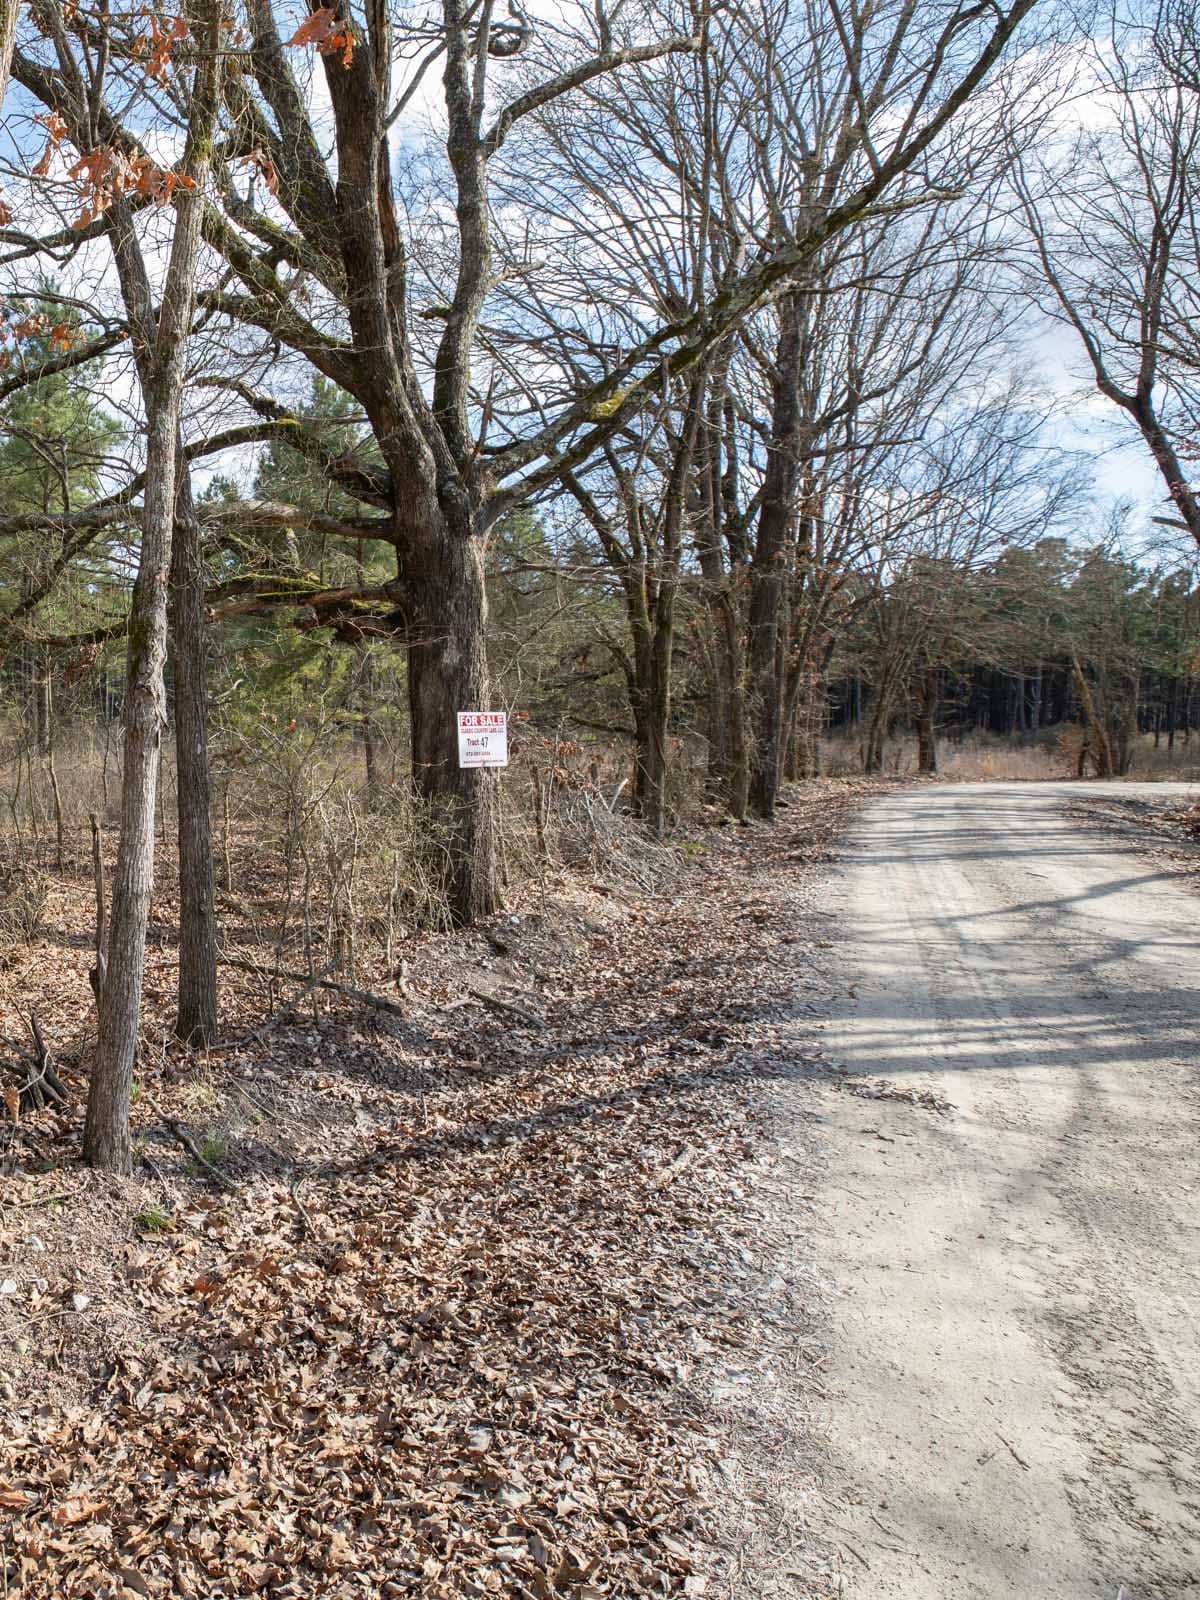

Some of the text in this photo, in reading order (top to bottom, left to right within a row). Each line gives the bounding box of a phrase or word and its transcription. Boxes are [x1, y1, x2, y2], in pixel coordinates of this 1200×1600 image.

[460, 715, 504, 726] FOR SALE
[467, 736, 489, 749] Tract 47
